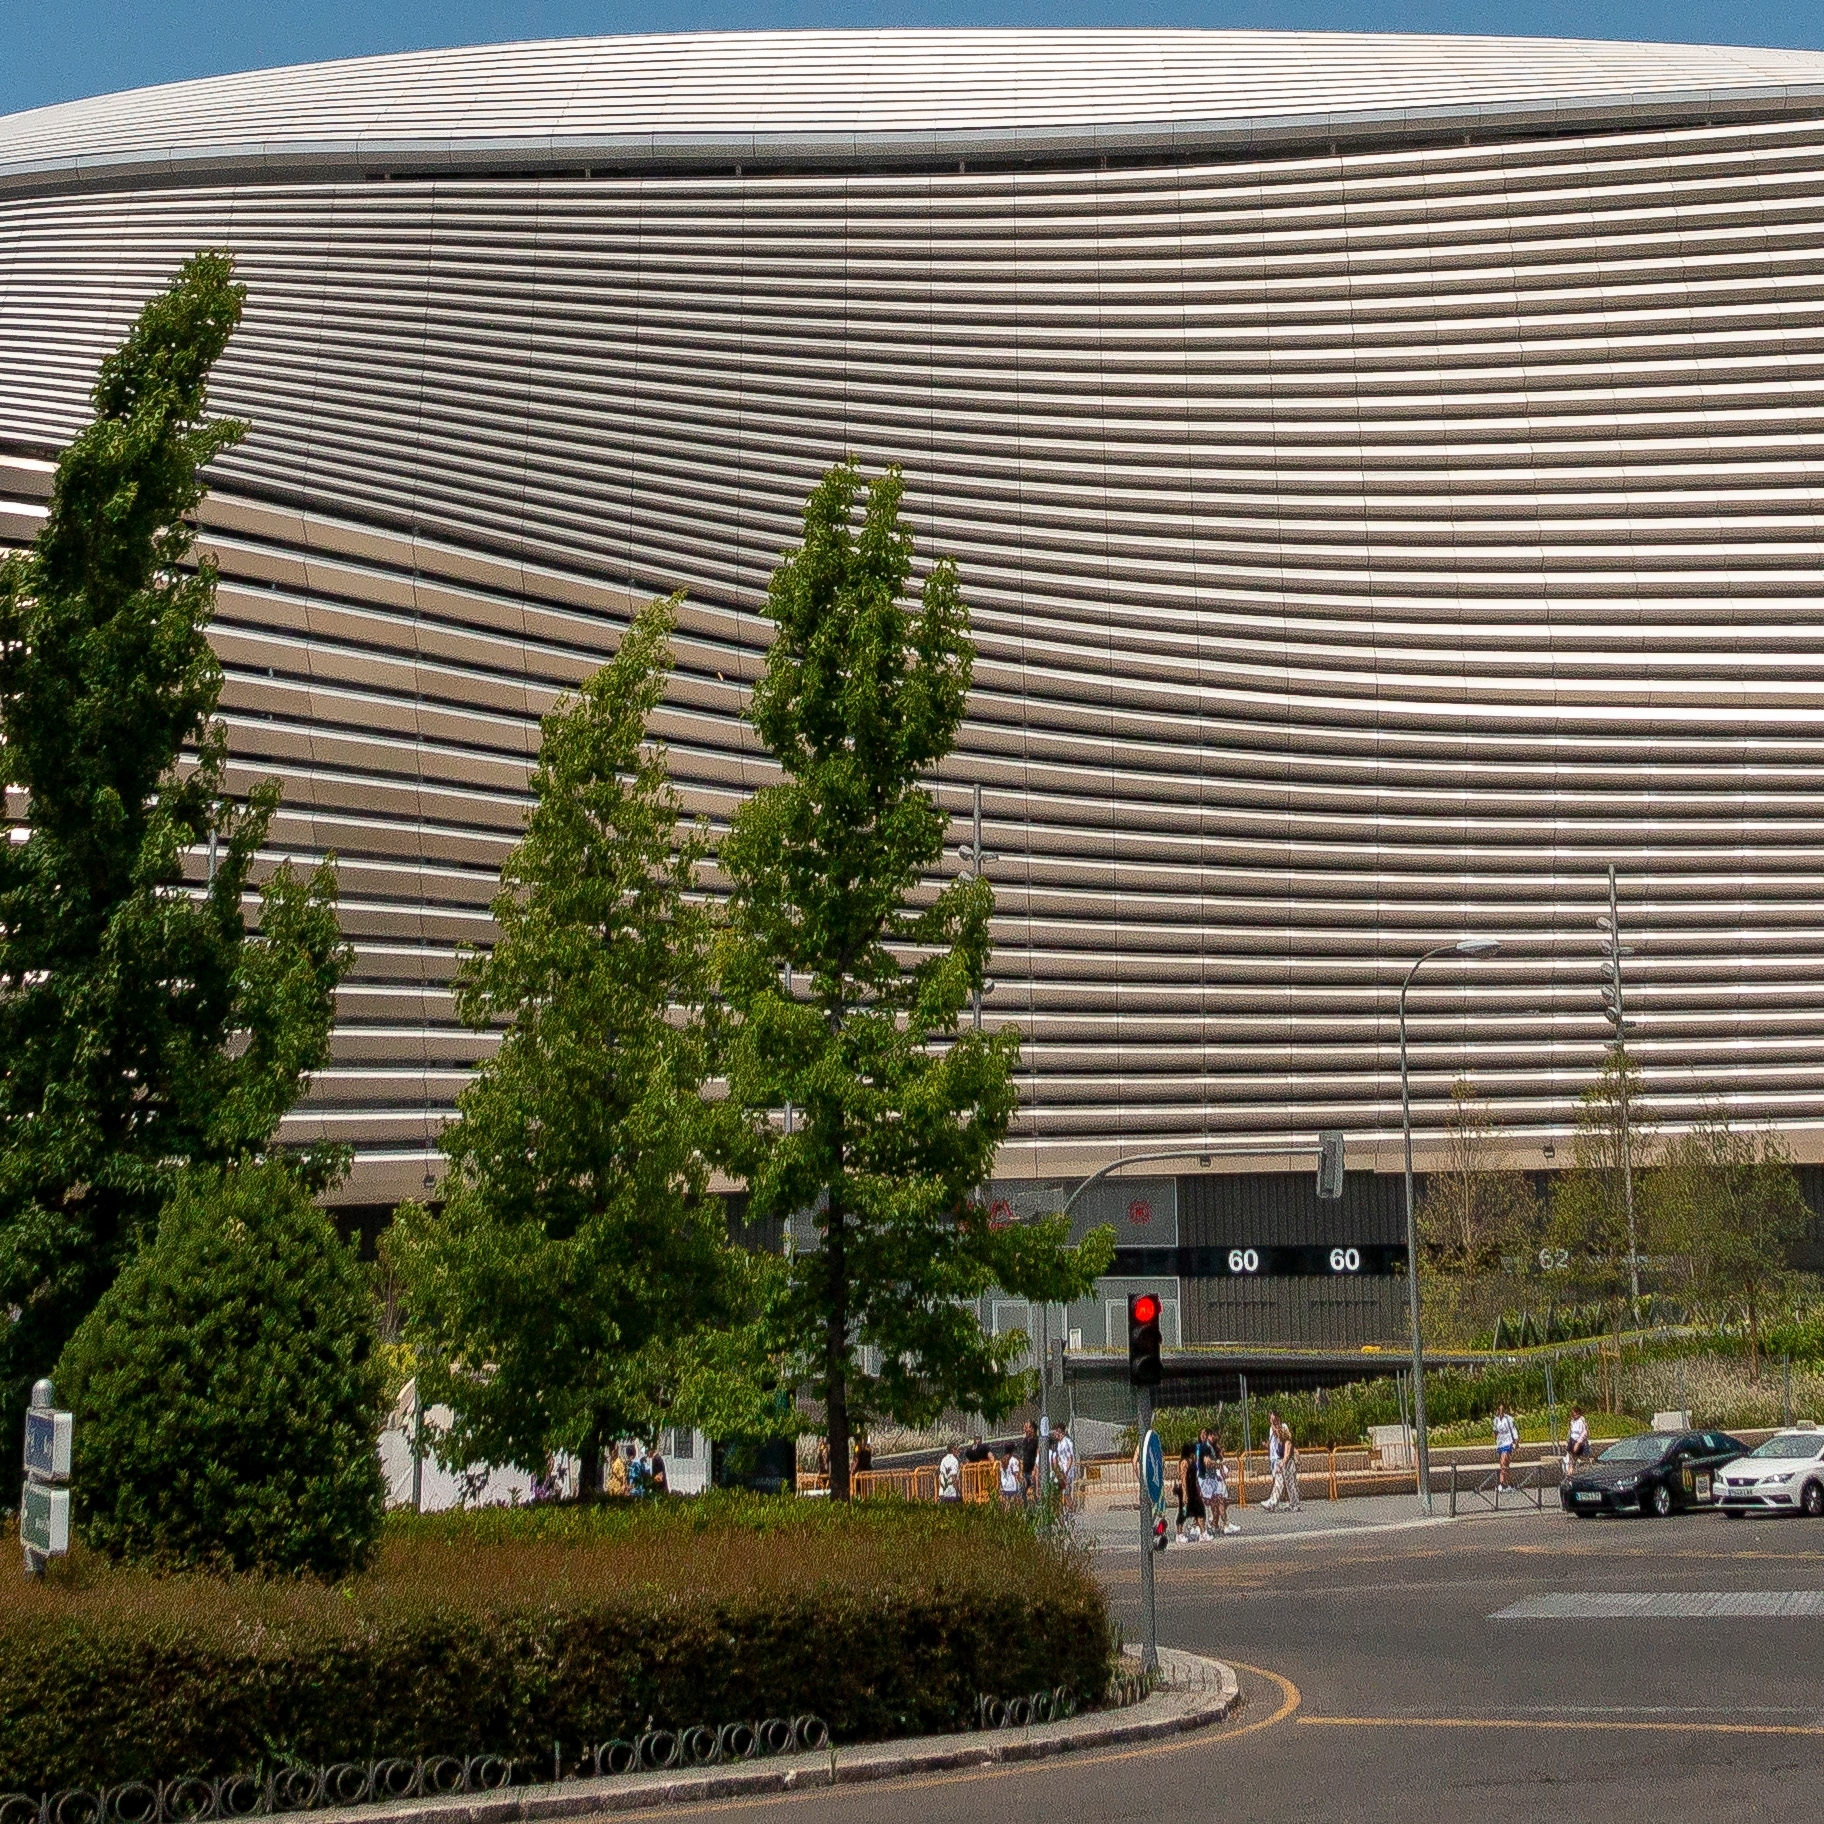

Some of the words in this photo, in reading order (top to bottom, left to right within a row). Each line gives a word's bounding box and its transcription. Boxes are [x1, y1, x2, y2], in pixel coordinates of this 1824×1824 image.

[1229, 1249, 1259, 1272] 60
[1330, 1248, 1360, 1271] 60
[1539, 1248, 1570, 1270] 62
